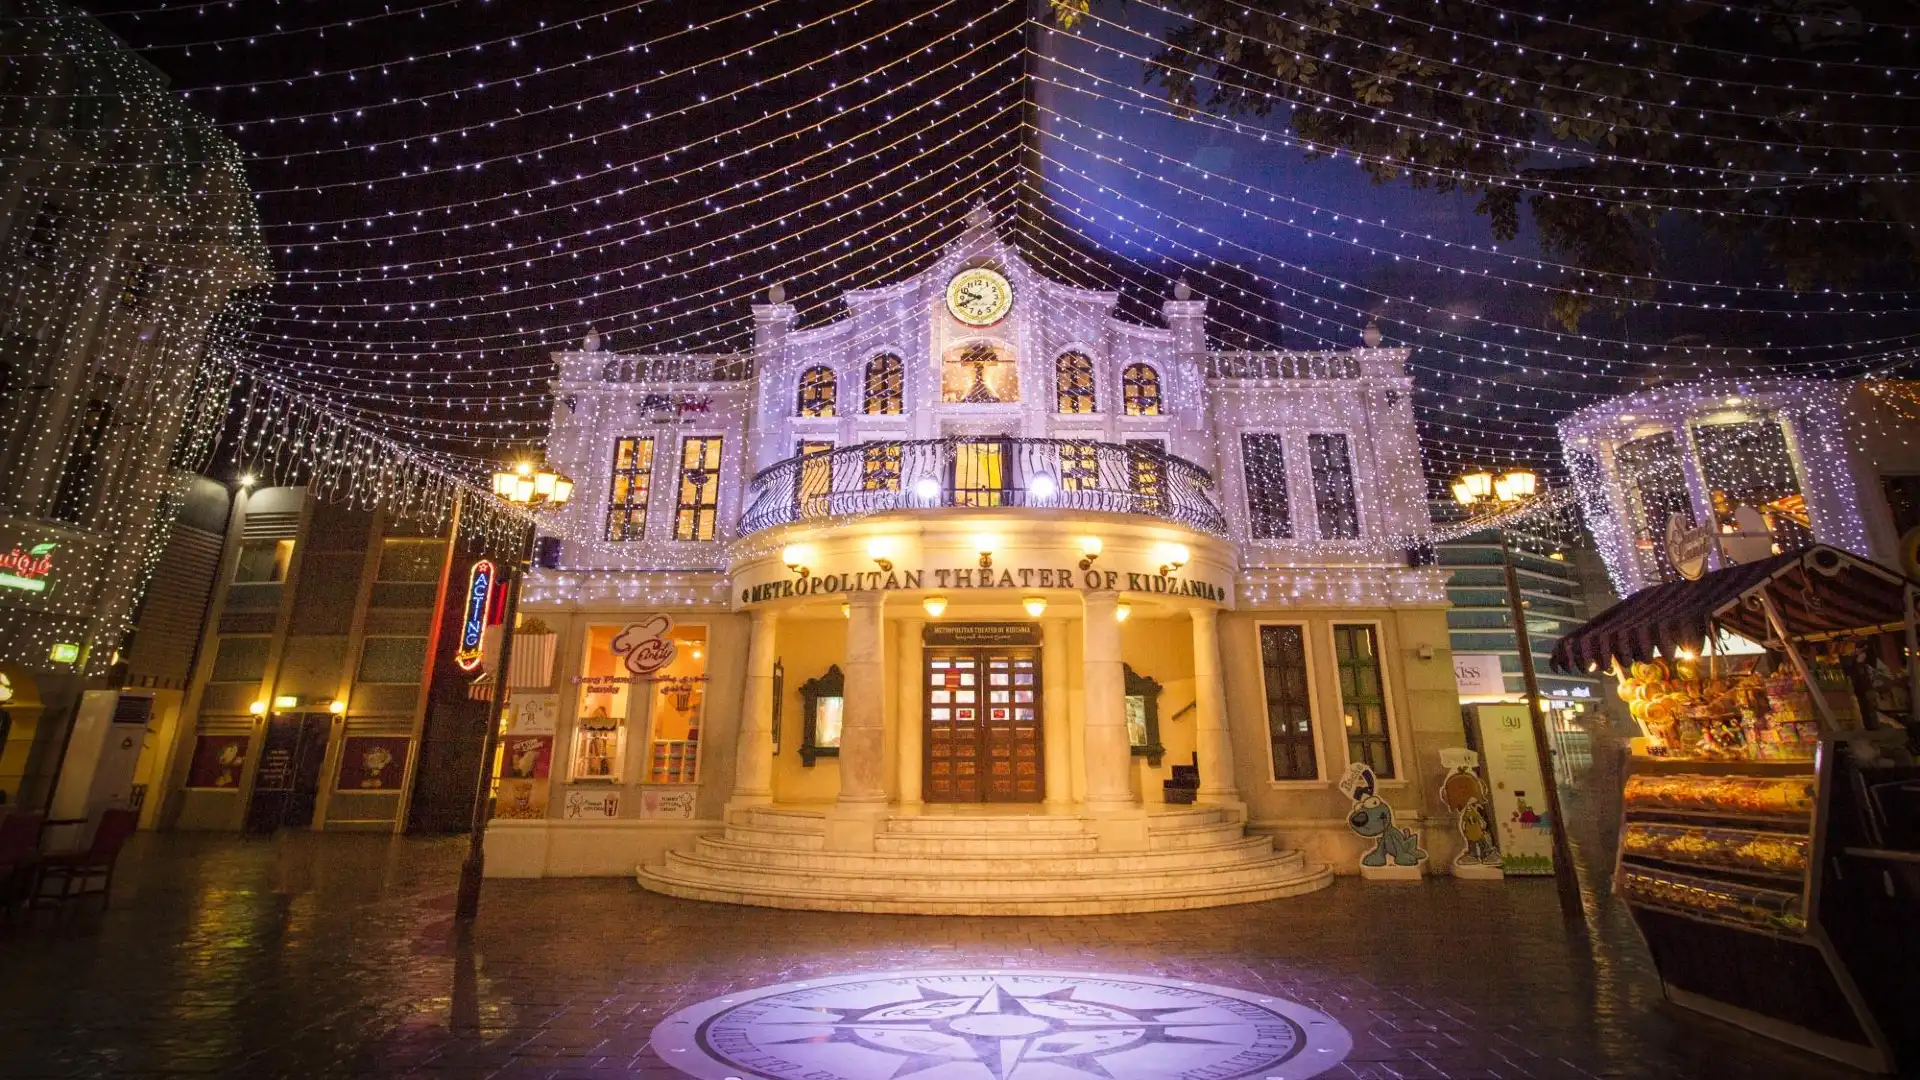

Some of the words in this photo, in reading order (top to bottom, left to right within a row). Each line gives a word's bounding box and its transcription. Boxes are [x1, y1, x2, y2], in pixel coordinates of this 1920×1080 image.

[466, 573, 488, 646] ACTING
[752, 569, 925, 603] METROPOLITAN
[935, 567, 1074, 589] THEATER
[1085, 569, 1118, 590] OF
[1128, 572, 1217, 601] KIDZANIA
